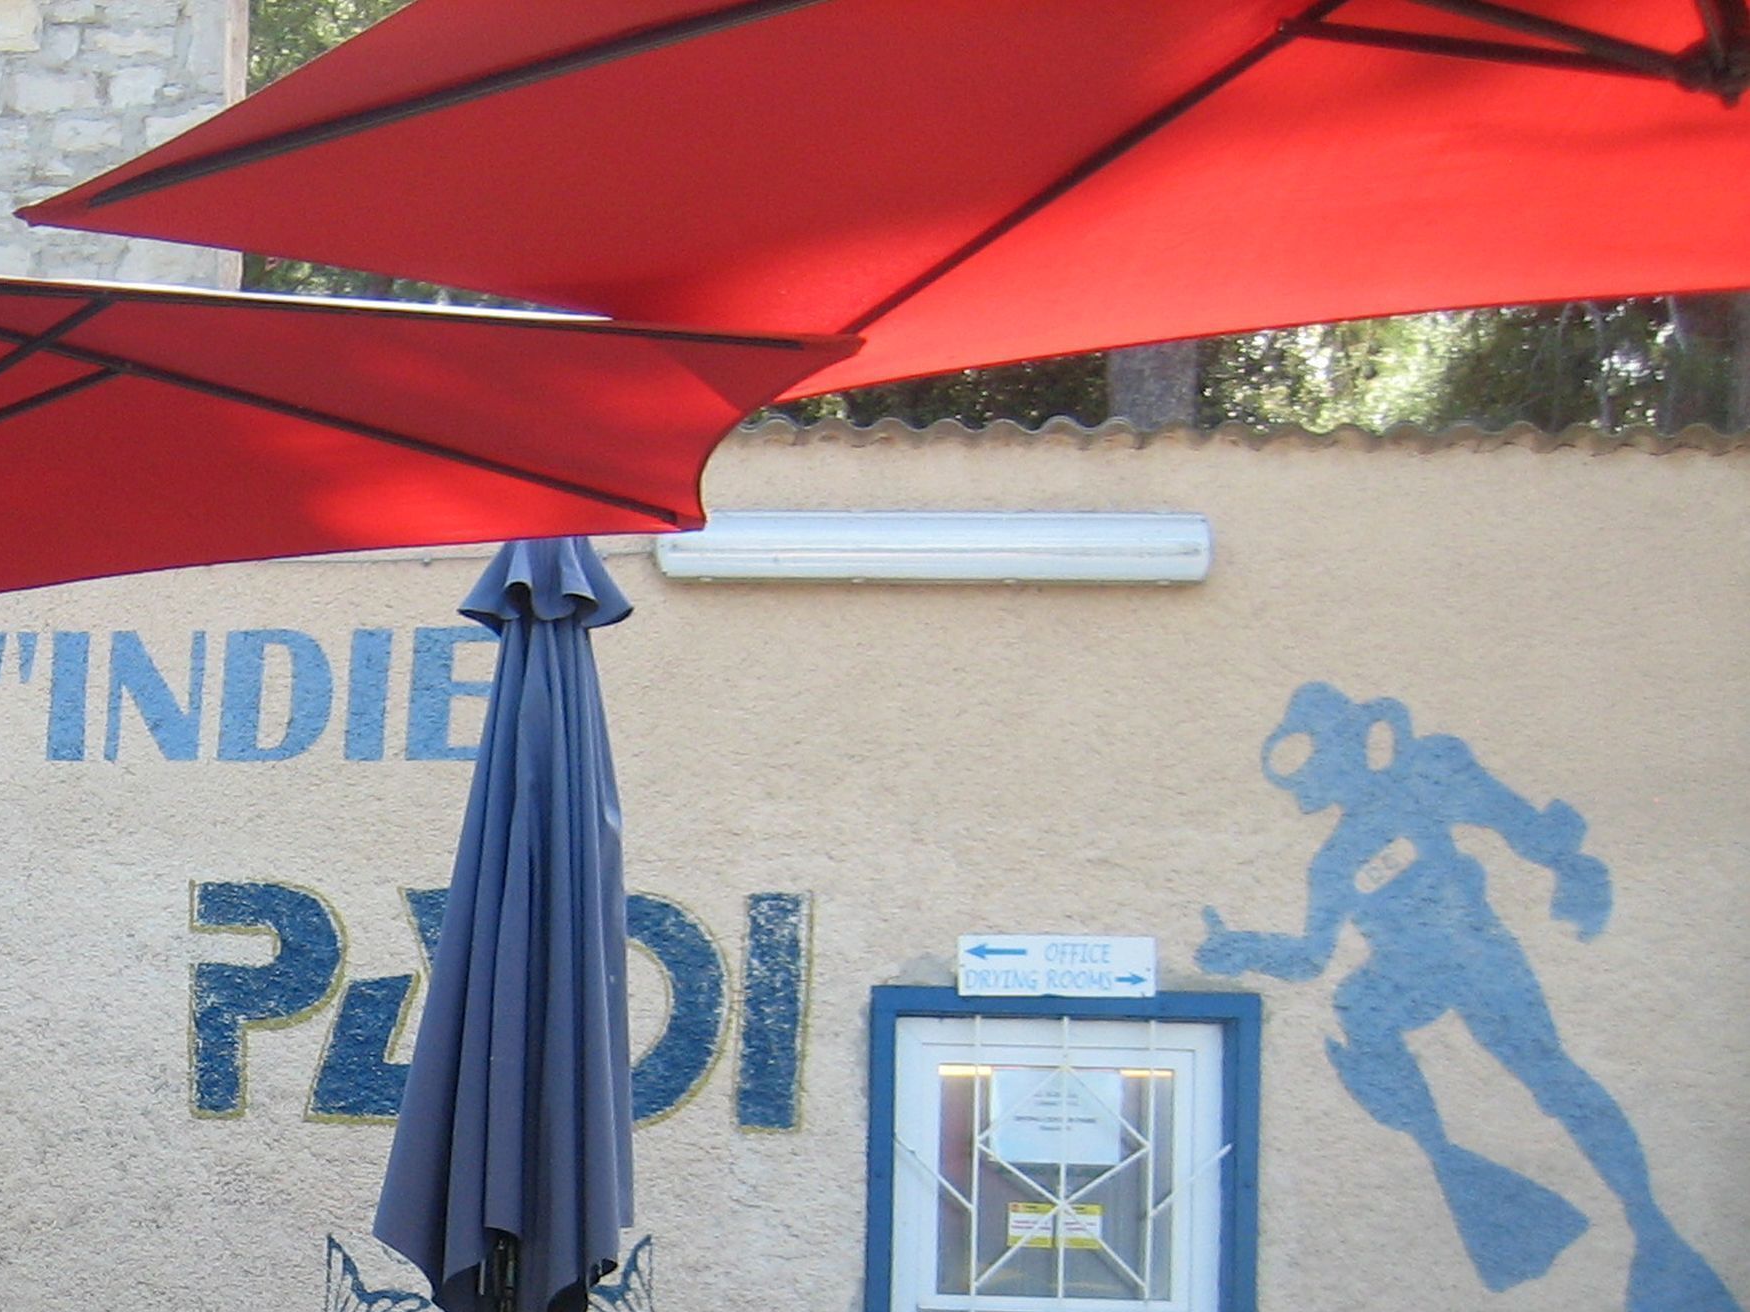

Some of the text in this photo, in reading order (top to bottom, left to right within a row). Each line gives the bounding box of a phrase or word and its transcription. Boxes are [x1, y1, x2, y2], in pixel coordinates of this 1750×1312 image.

[1045, 943, 1111, 965] OFFICE
[965, 969, 1113, 990] DRYING ROOMS
